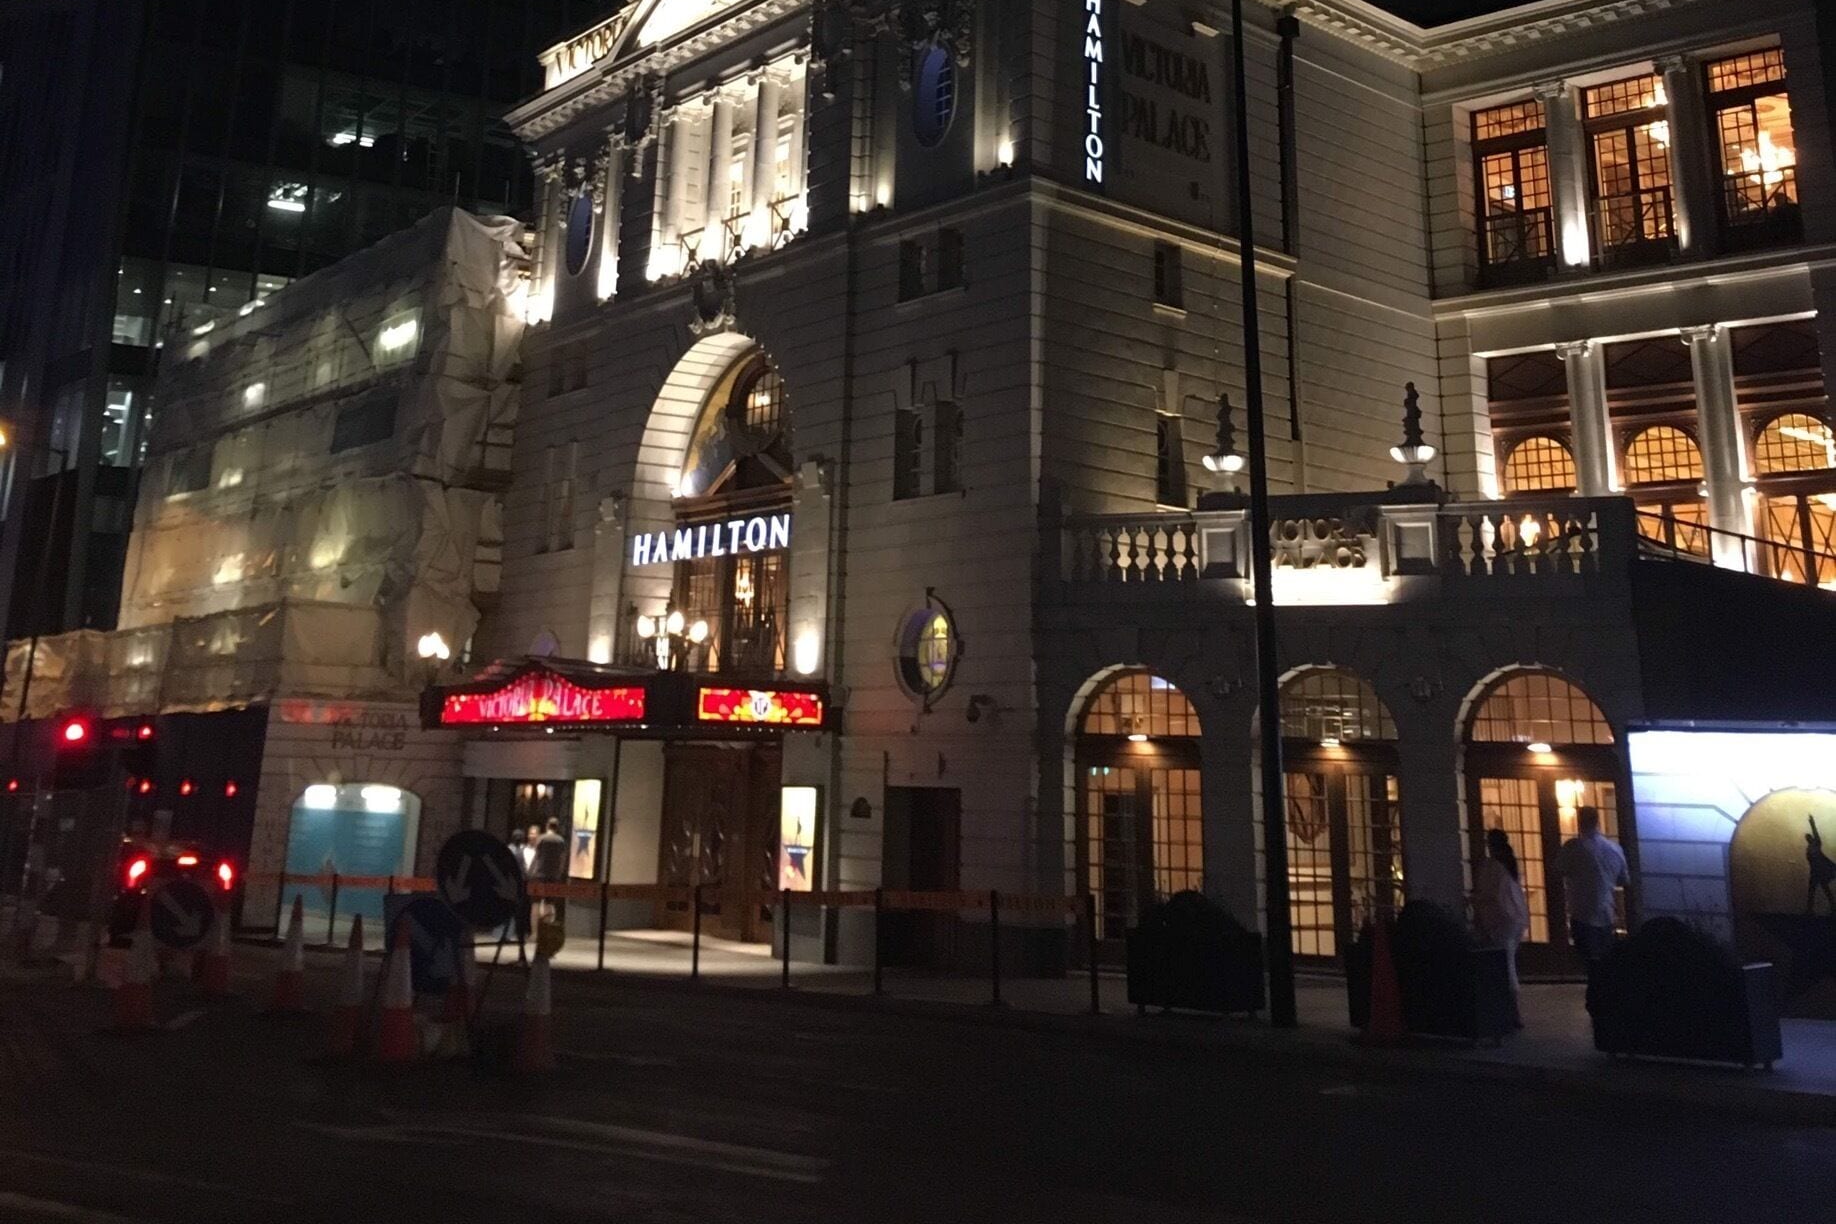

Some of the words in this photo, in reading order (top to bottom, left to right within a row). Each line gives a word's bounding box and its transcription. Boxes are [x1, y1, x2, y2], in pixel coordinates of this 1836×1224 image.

[1120, 29, 1212, 104] VICTORIA
[1121, 90, 1211, 163] PALACE
[633, 514, 790, 566] HAMILTON
[479, 680, 536, 719] VICTORIA
[543, 679, 603, 716] PALACE
[332, 731, 406, 750] PALACE
